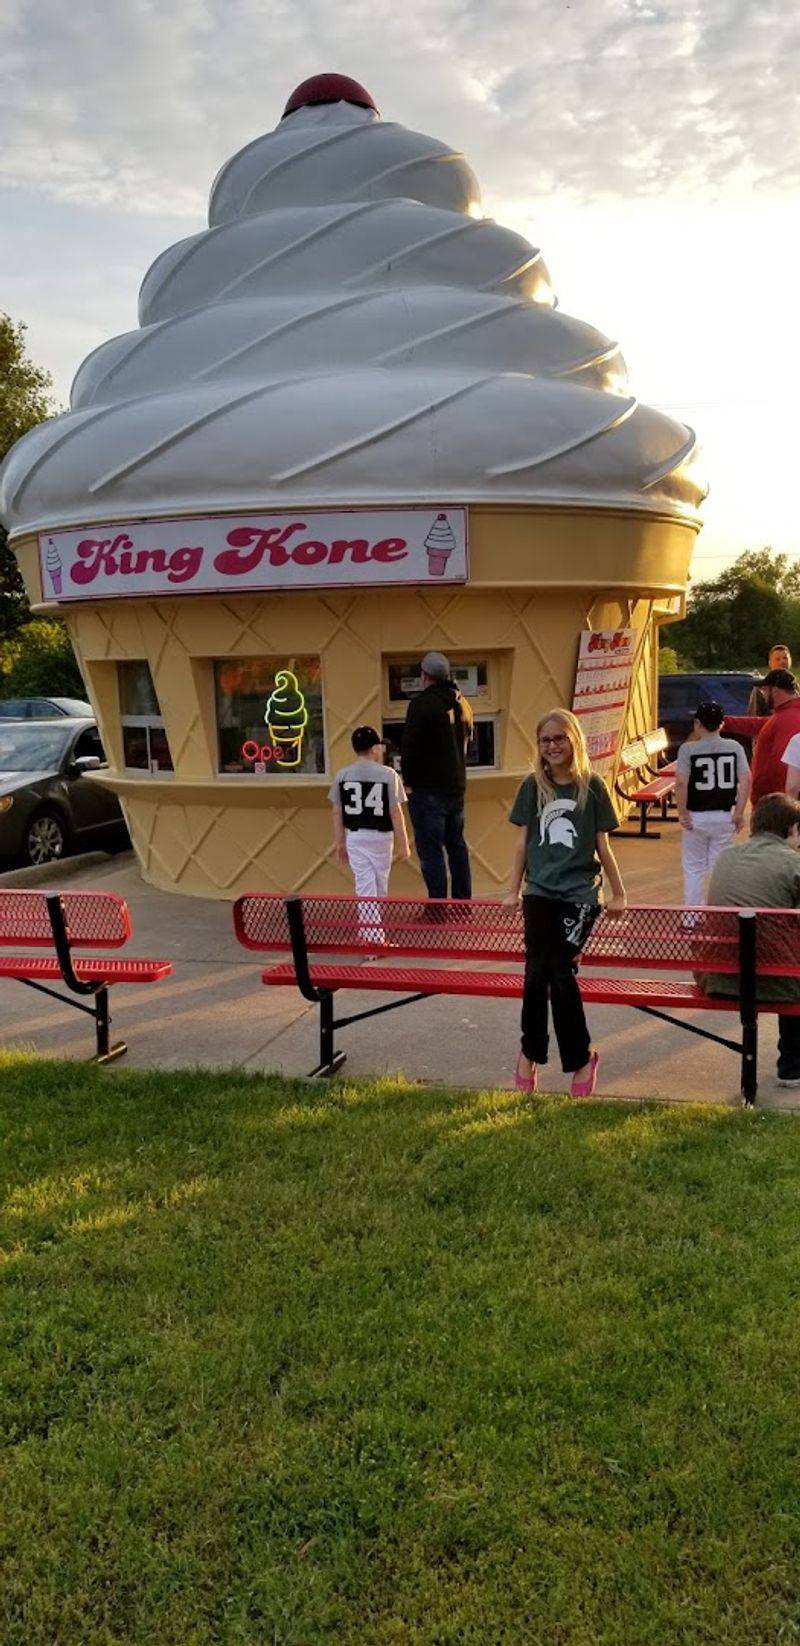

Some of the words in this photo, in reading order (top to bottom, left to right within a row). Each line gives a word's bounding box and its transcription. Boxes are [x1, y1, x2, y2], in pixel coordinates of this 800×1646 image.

[70, 533, 205, 585] King
[213, 523, 408, 575] Kone
[694, 755, 735, 791] 30
[343, 781, 384, 816] 34
